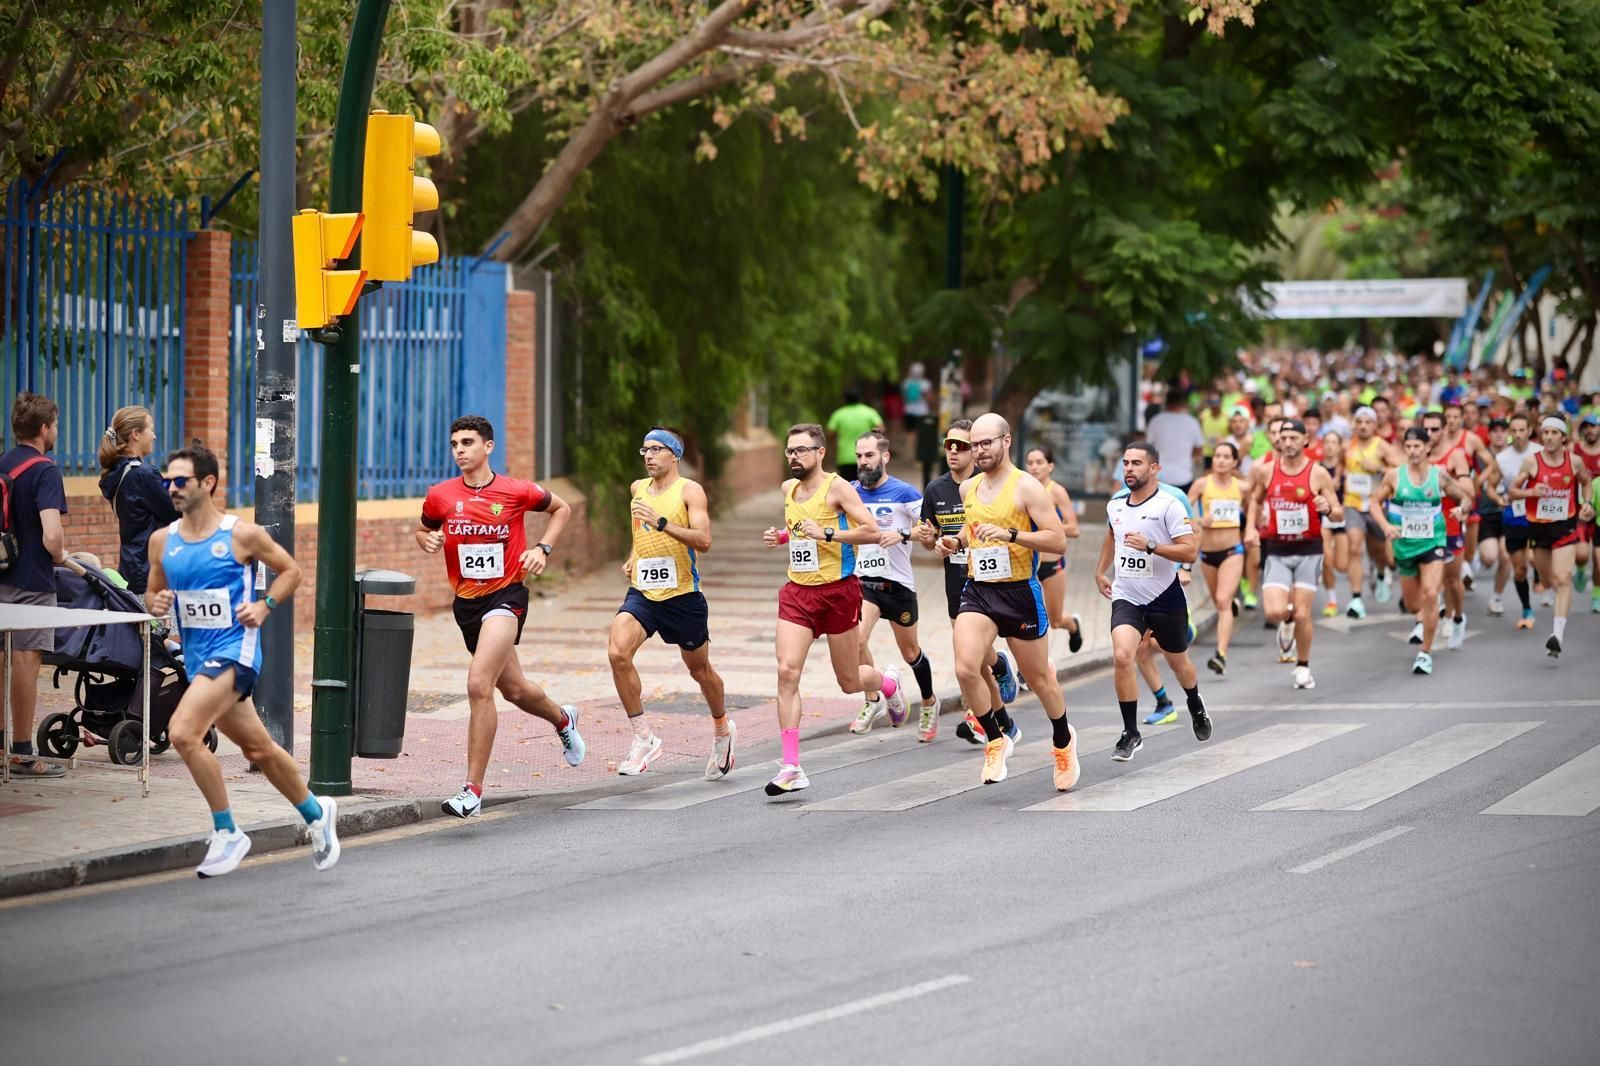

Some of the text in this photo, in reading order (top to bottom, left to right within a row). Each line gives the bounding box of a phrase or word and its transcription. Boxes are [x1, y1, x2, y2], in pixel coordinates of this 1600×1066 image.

[1213, 507, 1235, 518] 477
[1281, 518, 1304, 527] 732
[1406, 523, 1429, 532] 403
[448, 524, 510, 535] CÁRTAMA
[465, 556, 495, 568] 241
[858, 558, 886, 569] 1200
[979, 558, 998, 571] 33
[1120, 556, 1146, 569] 790
[641, 568, 669, 580] 796
[185, 603, 222, 617] 510
